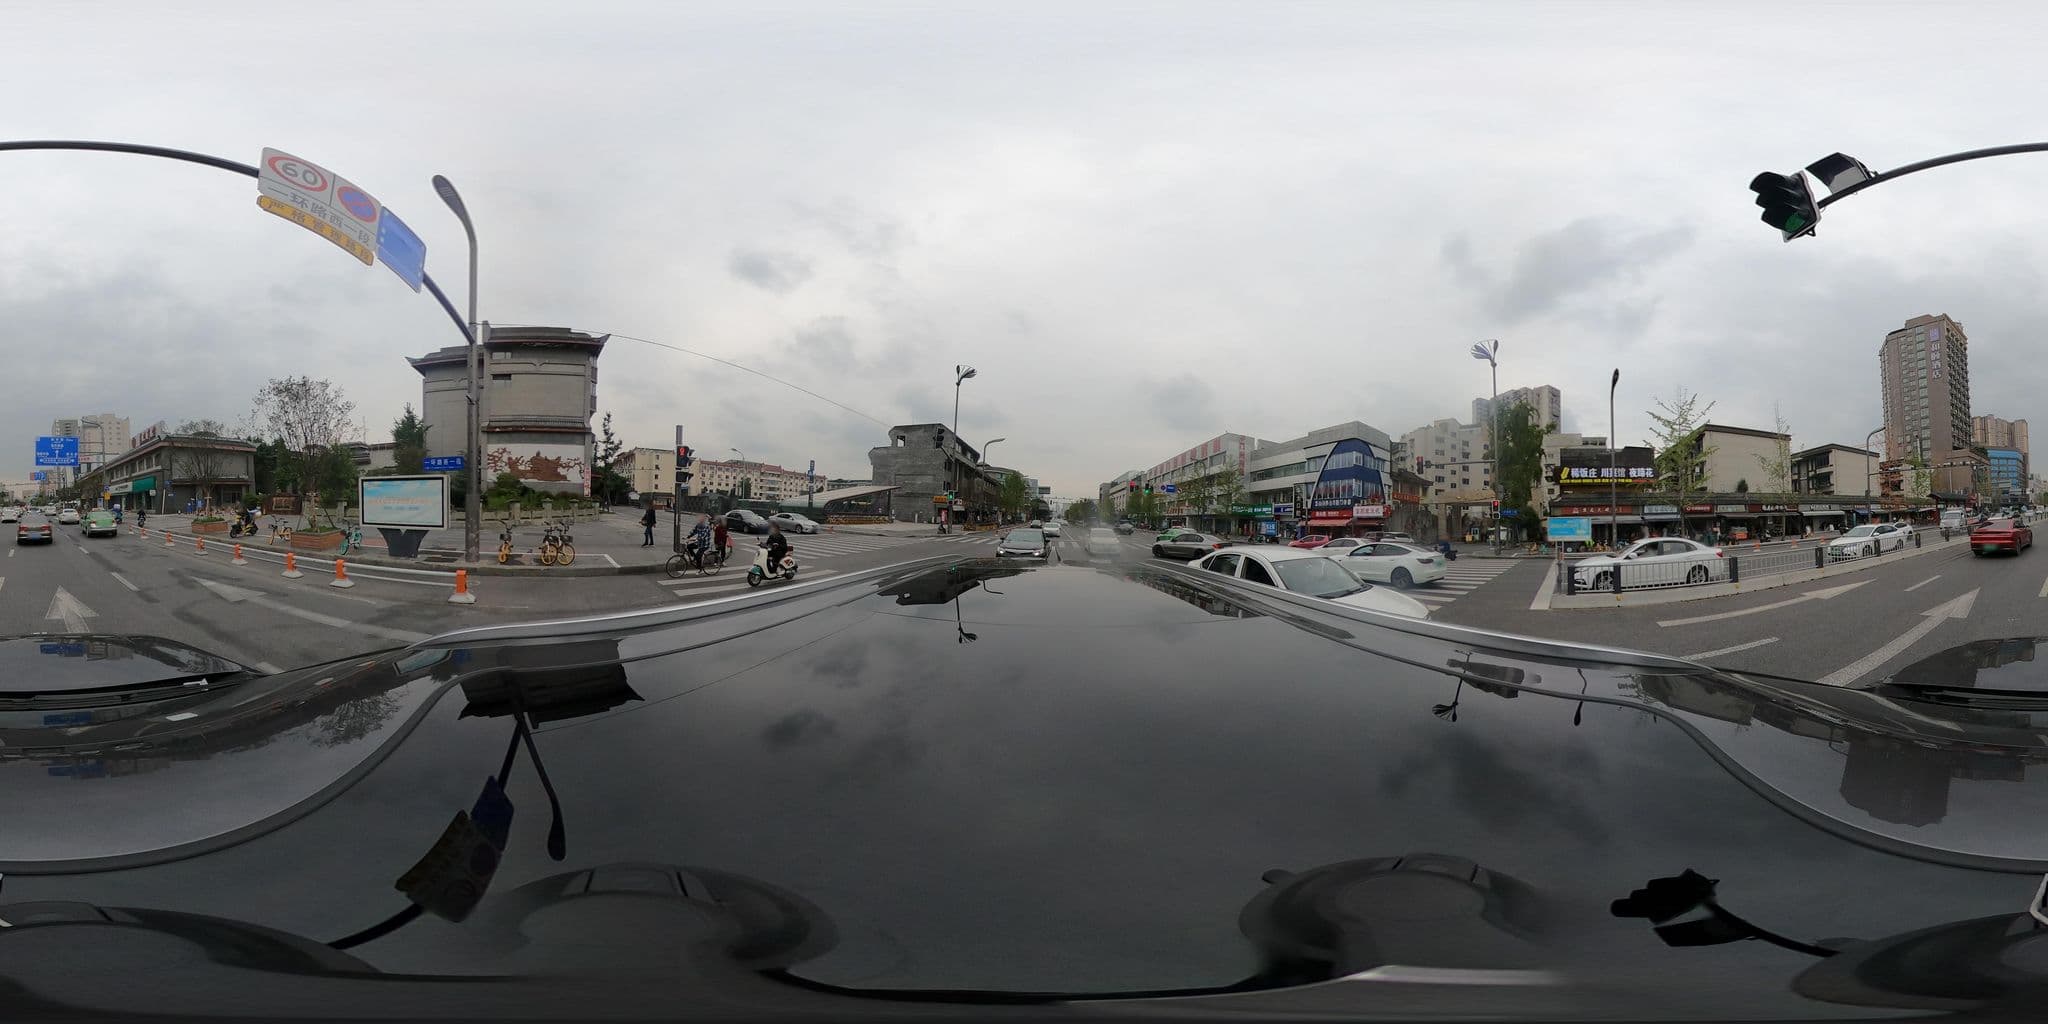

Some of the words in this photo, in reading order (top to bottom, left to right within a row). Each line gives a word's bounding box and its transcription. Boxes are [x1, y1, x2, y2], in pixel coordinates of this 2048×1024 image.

[281, 163, 318, 185] 60
[267, 186, 370, 246] 一环路西一段
